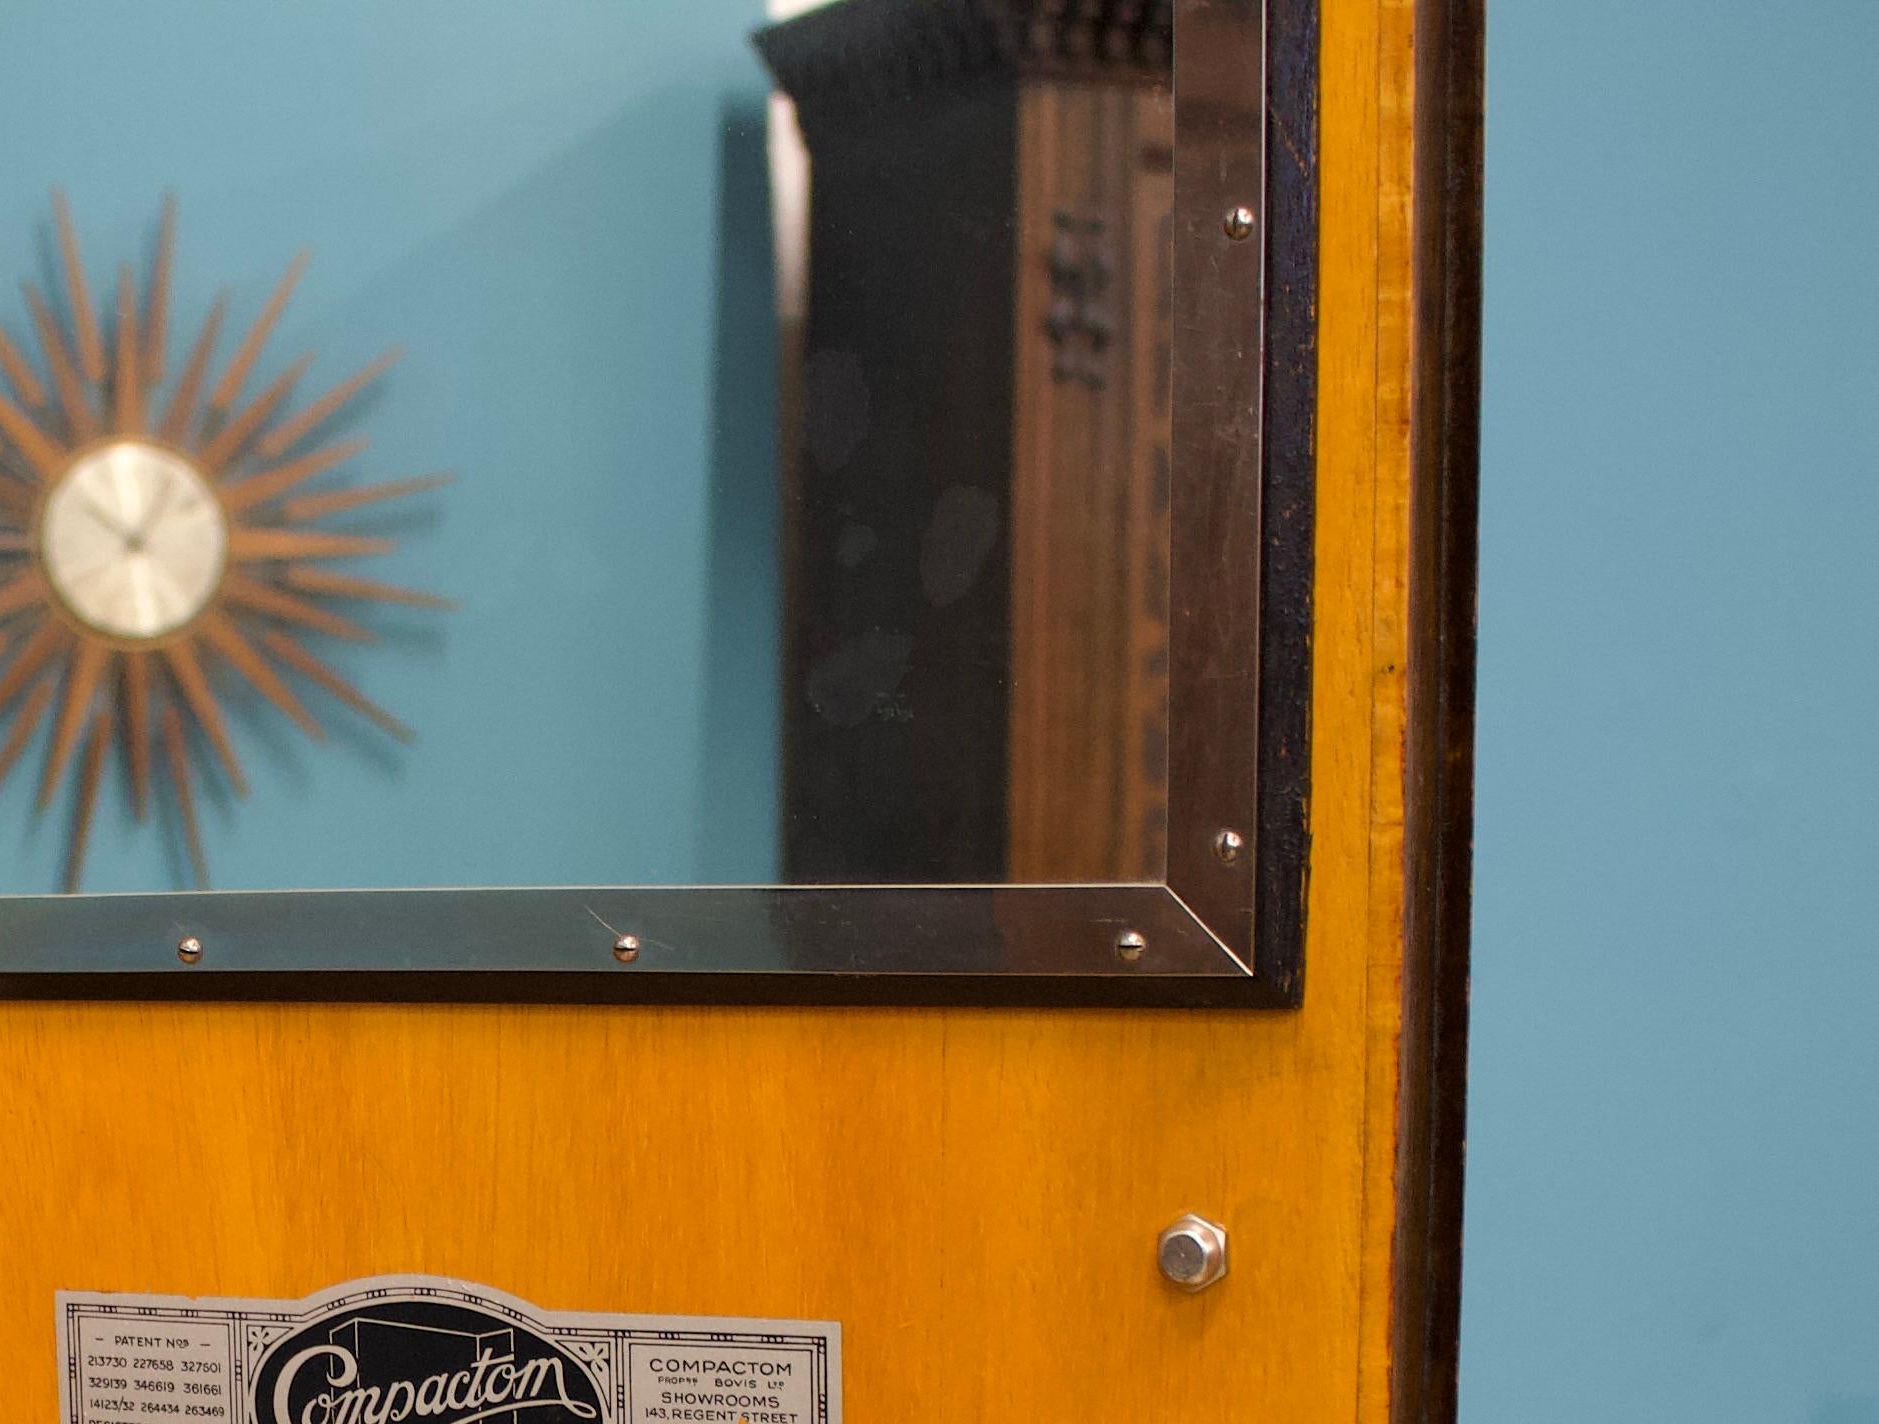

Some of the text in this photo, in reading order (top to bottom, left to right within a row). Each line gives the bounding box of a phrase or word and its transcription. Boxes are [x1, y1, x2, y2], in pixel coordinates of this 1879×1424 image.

[114, 1335, 161, 1348] PATENT
[88, 1355, 127, 1368] 213730
[133, 1358, 174, 1371] 227658
[649, 1358, 792, 1376] COMPACTOM
[89, 1377, 127, 1389] 329139
[134, 1379, 175, 1393] 346619
[715, 1378, 757, 1389] BOVIS
[661, 1392, 780, 1409] SHOWROOMS
[741, 1412, 798, 1424] STREET
